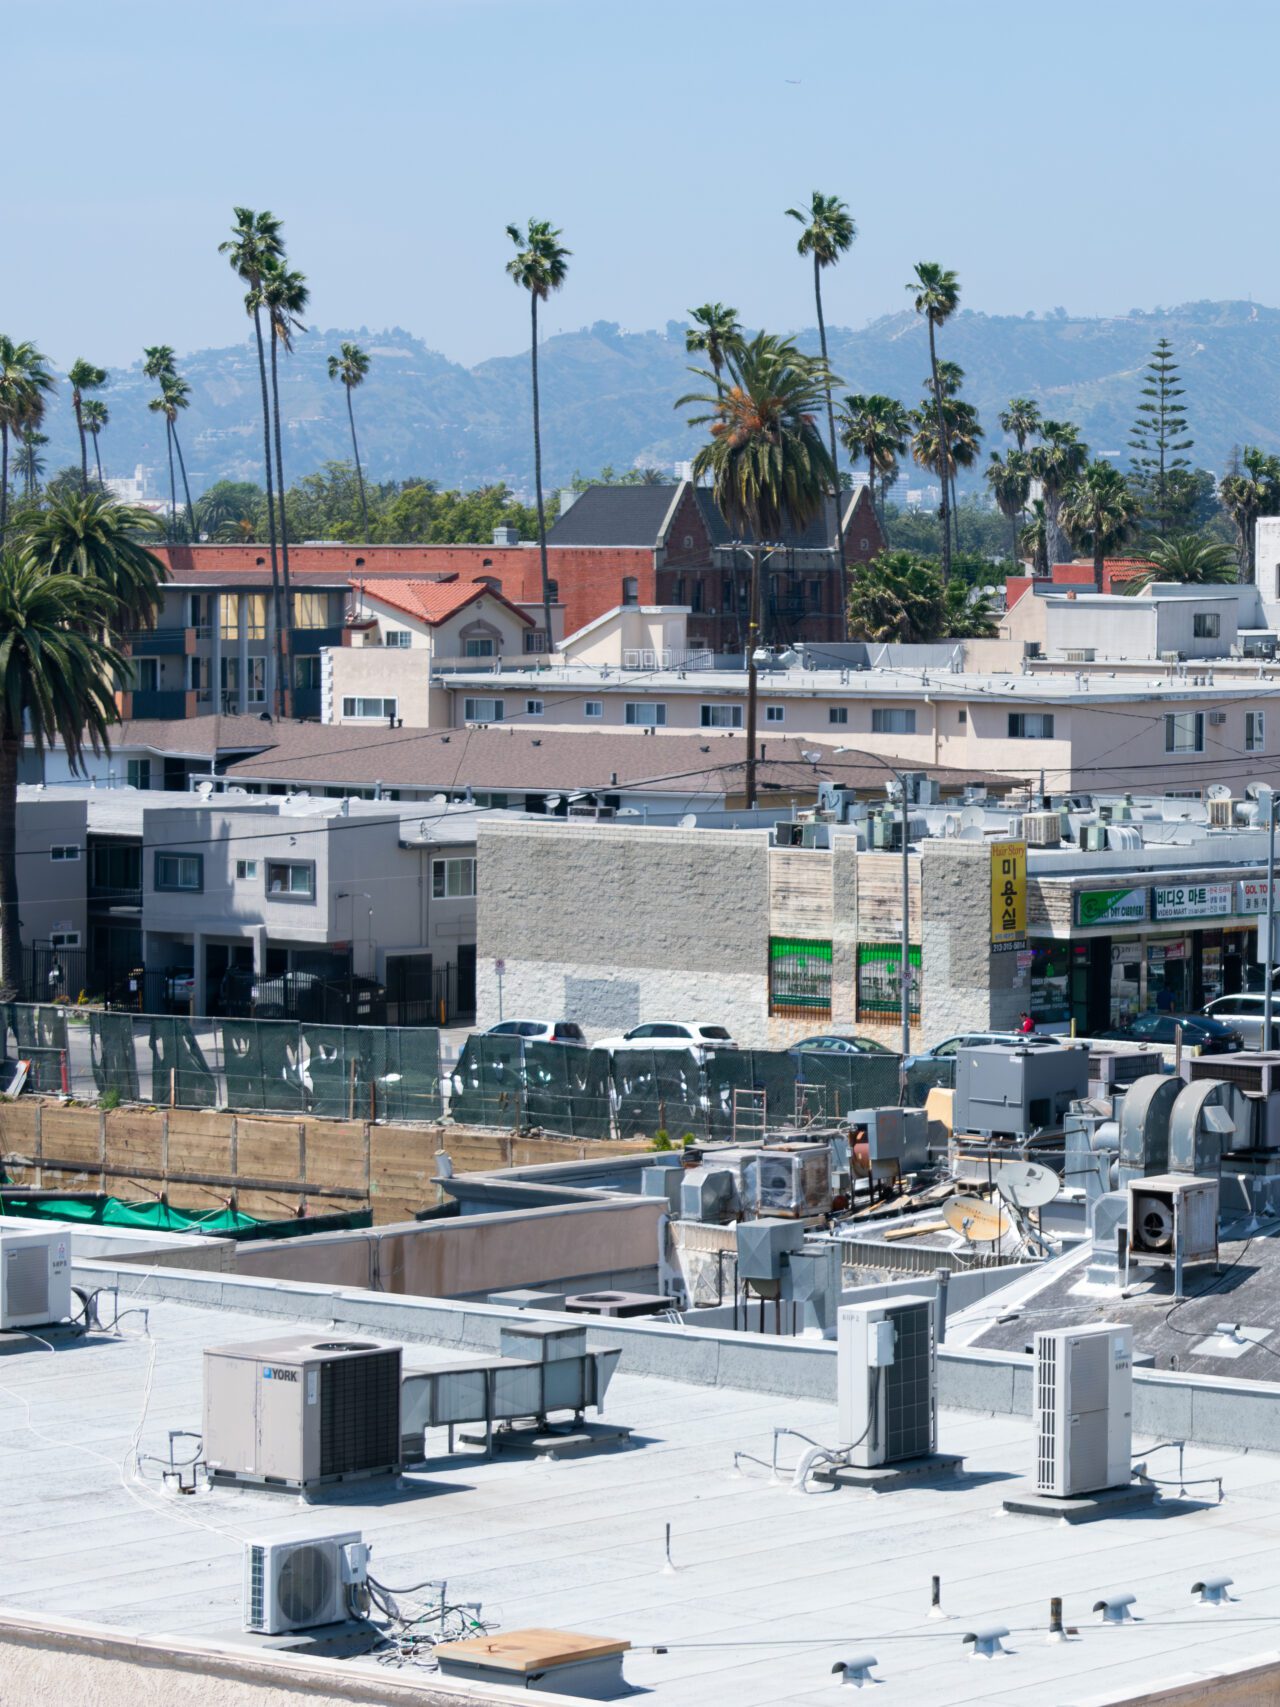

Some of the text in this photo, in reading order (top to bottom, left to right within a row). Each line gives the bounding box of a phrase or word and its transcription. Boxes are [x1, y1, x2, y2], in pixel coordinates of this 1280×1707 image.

[992, 844, 1025, 858] Hair Story
[1000, 858, 1018, 930] 미용실
[1245, 883, 1276, 895] GOL TOG
[1157, 888, 1207, 907] 비디오 마트
[1158, 908, 1173, 916] VIDEO
[1173, 907, 1187, 916] MART
[272, 1367, 297, 1382] YORK
